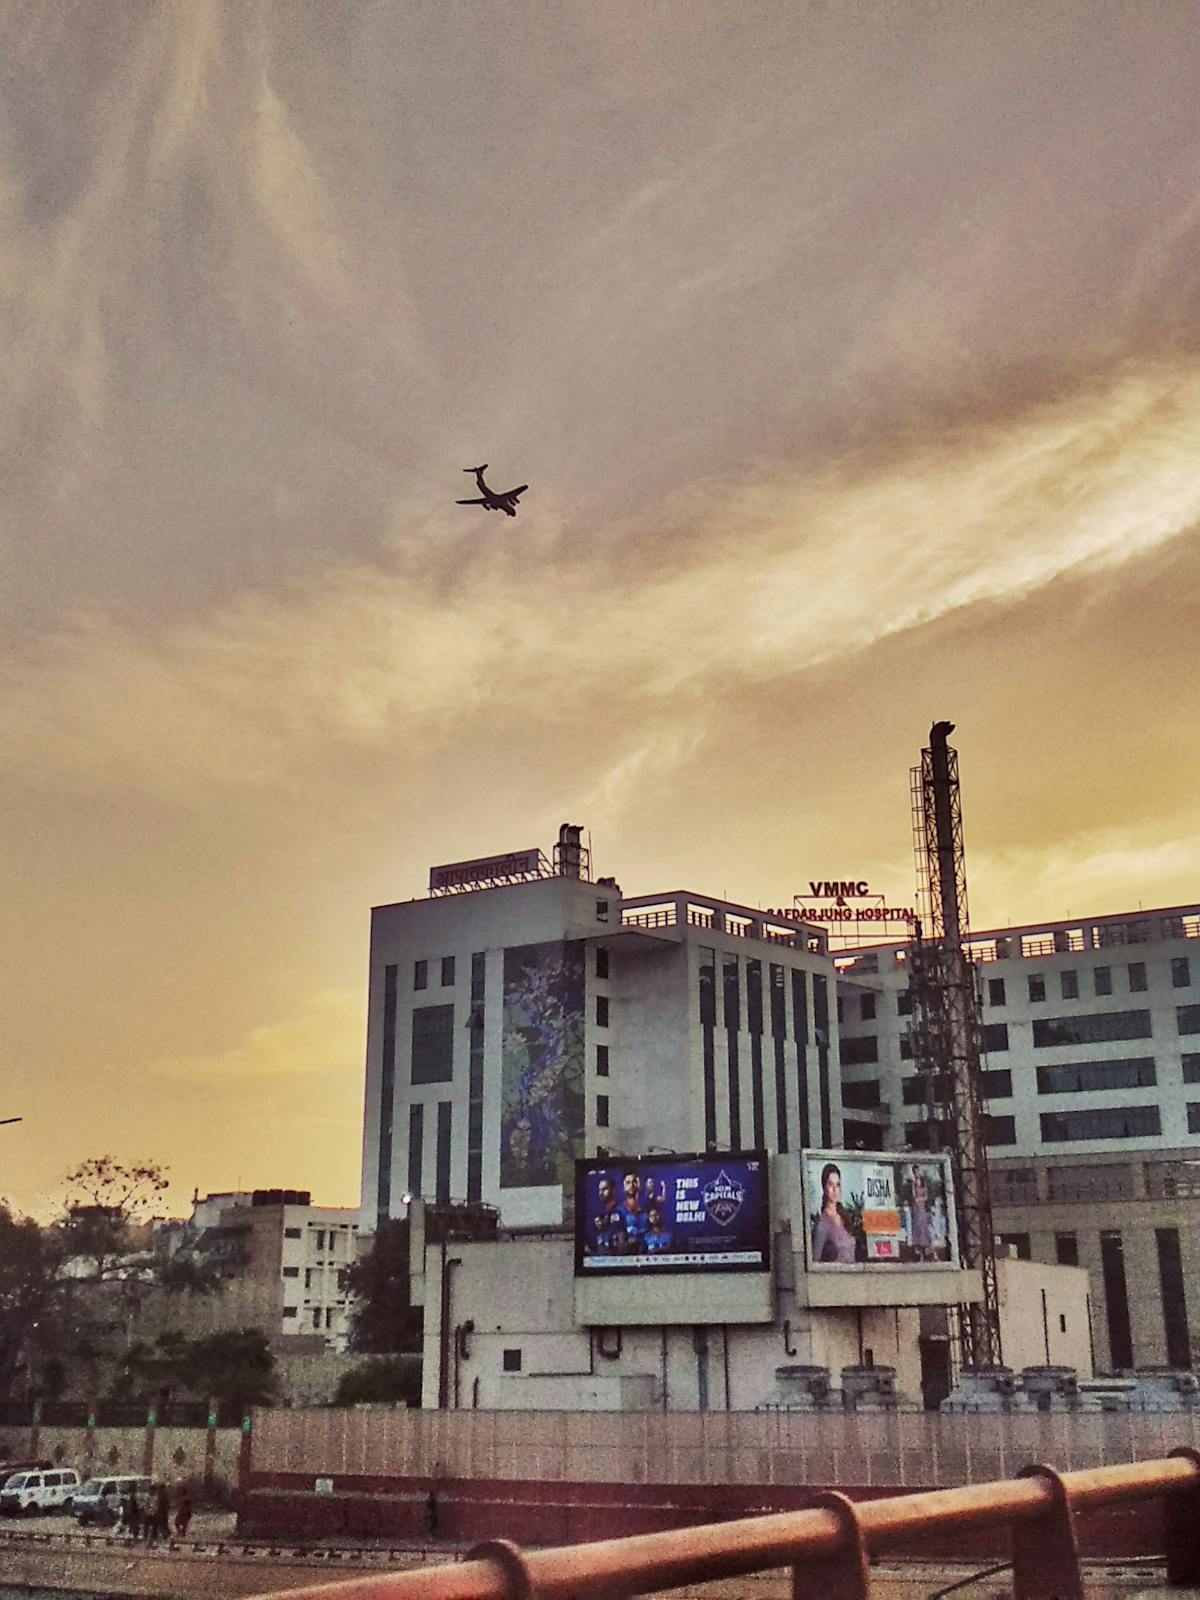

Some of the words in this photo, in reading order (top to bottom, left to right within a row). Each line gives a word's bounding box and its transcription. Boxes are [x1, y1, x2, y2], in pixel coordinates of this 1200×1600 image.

[809, 881, 869, 896] VMMC
[836, 896, 846, 907] &
[856, 907, 917, 921] HOSPITAL
[676, 1178, 699, 1190] THIS
[867, 1177, 892, 1198] DISHA
[676, 1190, 686, 1201] IS
[676, 1200, 700, 1212] NEW
[676, 1211, 706, 1223] DELHI
